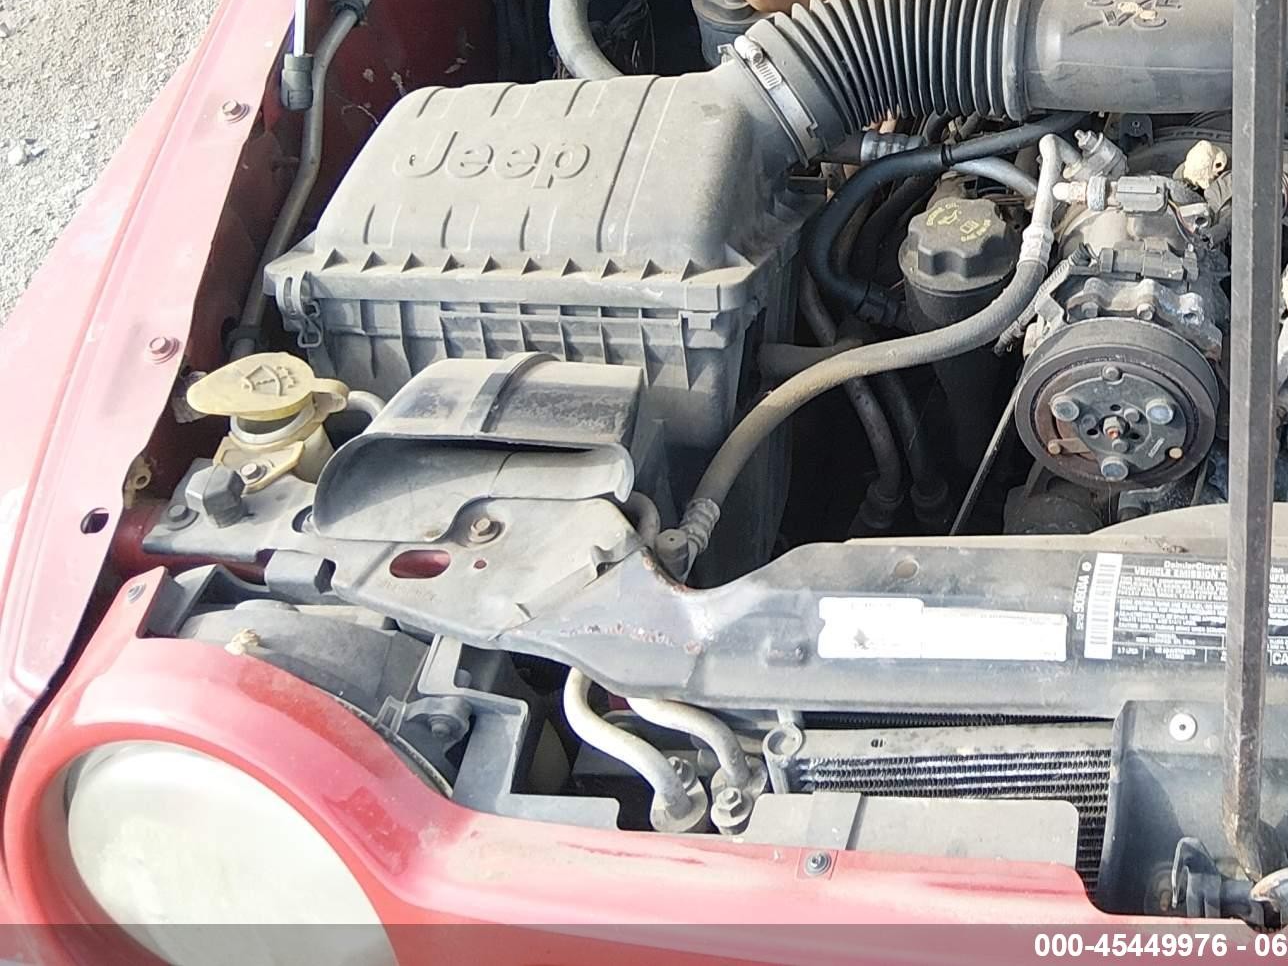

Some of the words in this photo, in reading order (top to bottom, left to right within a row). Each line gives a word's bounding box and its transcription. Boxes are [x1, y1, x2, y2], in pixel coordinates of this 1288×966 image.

[392, 131, 590, 189] Jeep
[1134, 566, 1171, 577] VEHICLE
[1173, 568, 1218, 580] EMISSION
[1163, 560, 1227, 572] DaimlerChrysle
